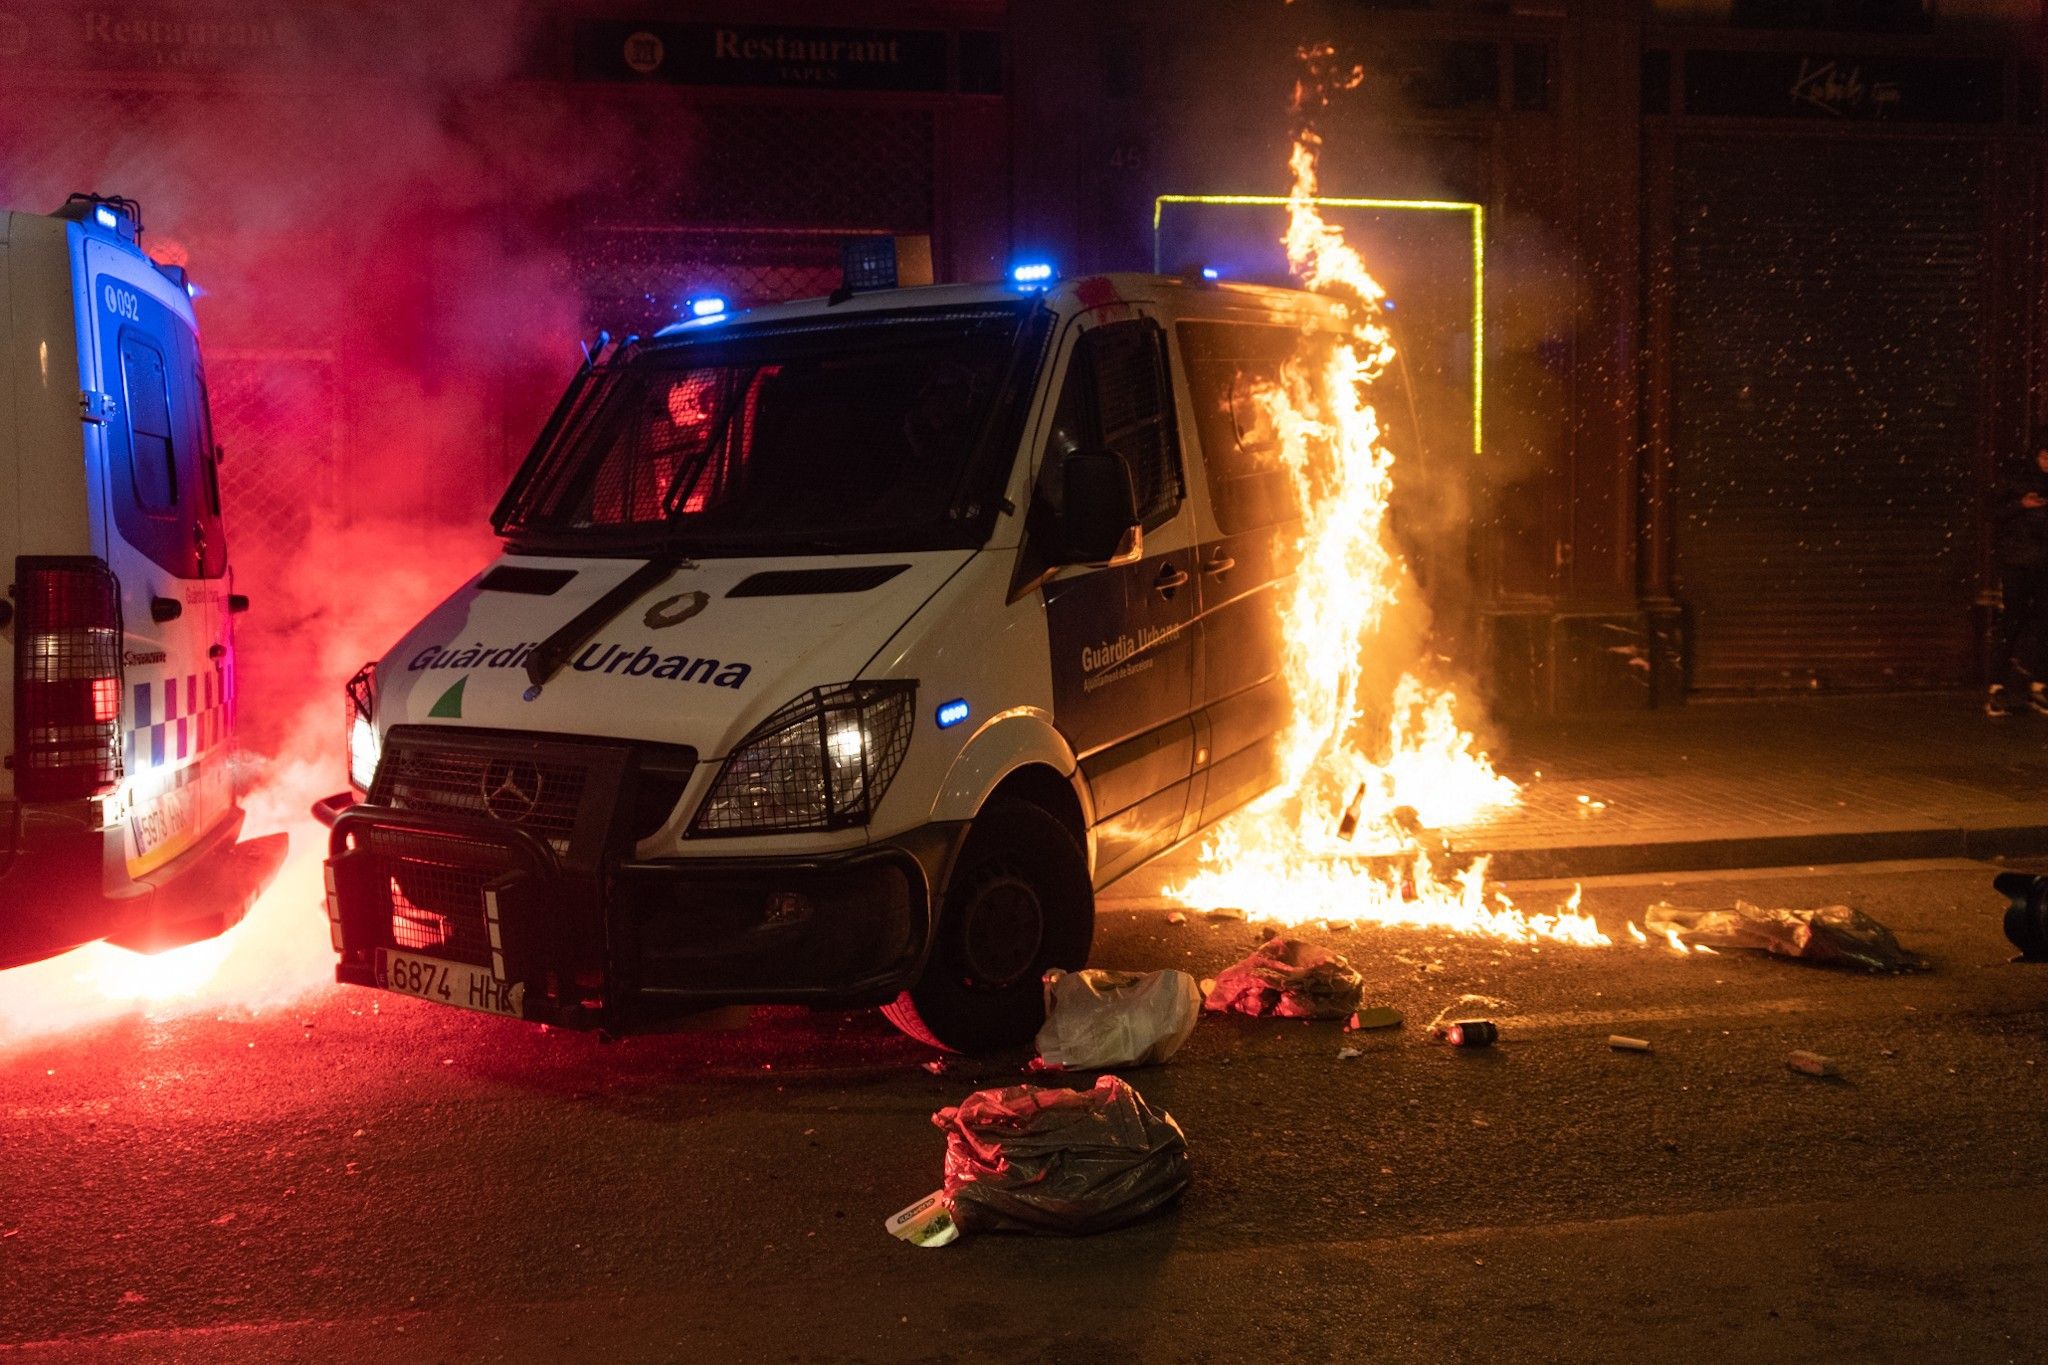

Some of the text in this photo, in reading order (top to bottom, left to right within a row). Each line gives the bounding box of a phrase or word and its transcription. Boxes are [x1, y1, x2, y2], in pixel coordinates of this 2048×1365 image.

[714, 29, 898, 63] Restaurant
[779, 66, 837, 81] TAPES
[117, 288, 139, 322] 092
[407, 642, 752, 690] Guàrdi Urbana
[1082, 634, 1135, 672] Guàrdia
[394, 958, 451, 1001] 6874
